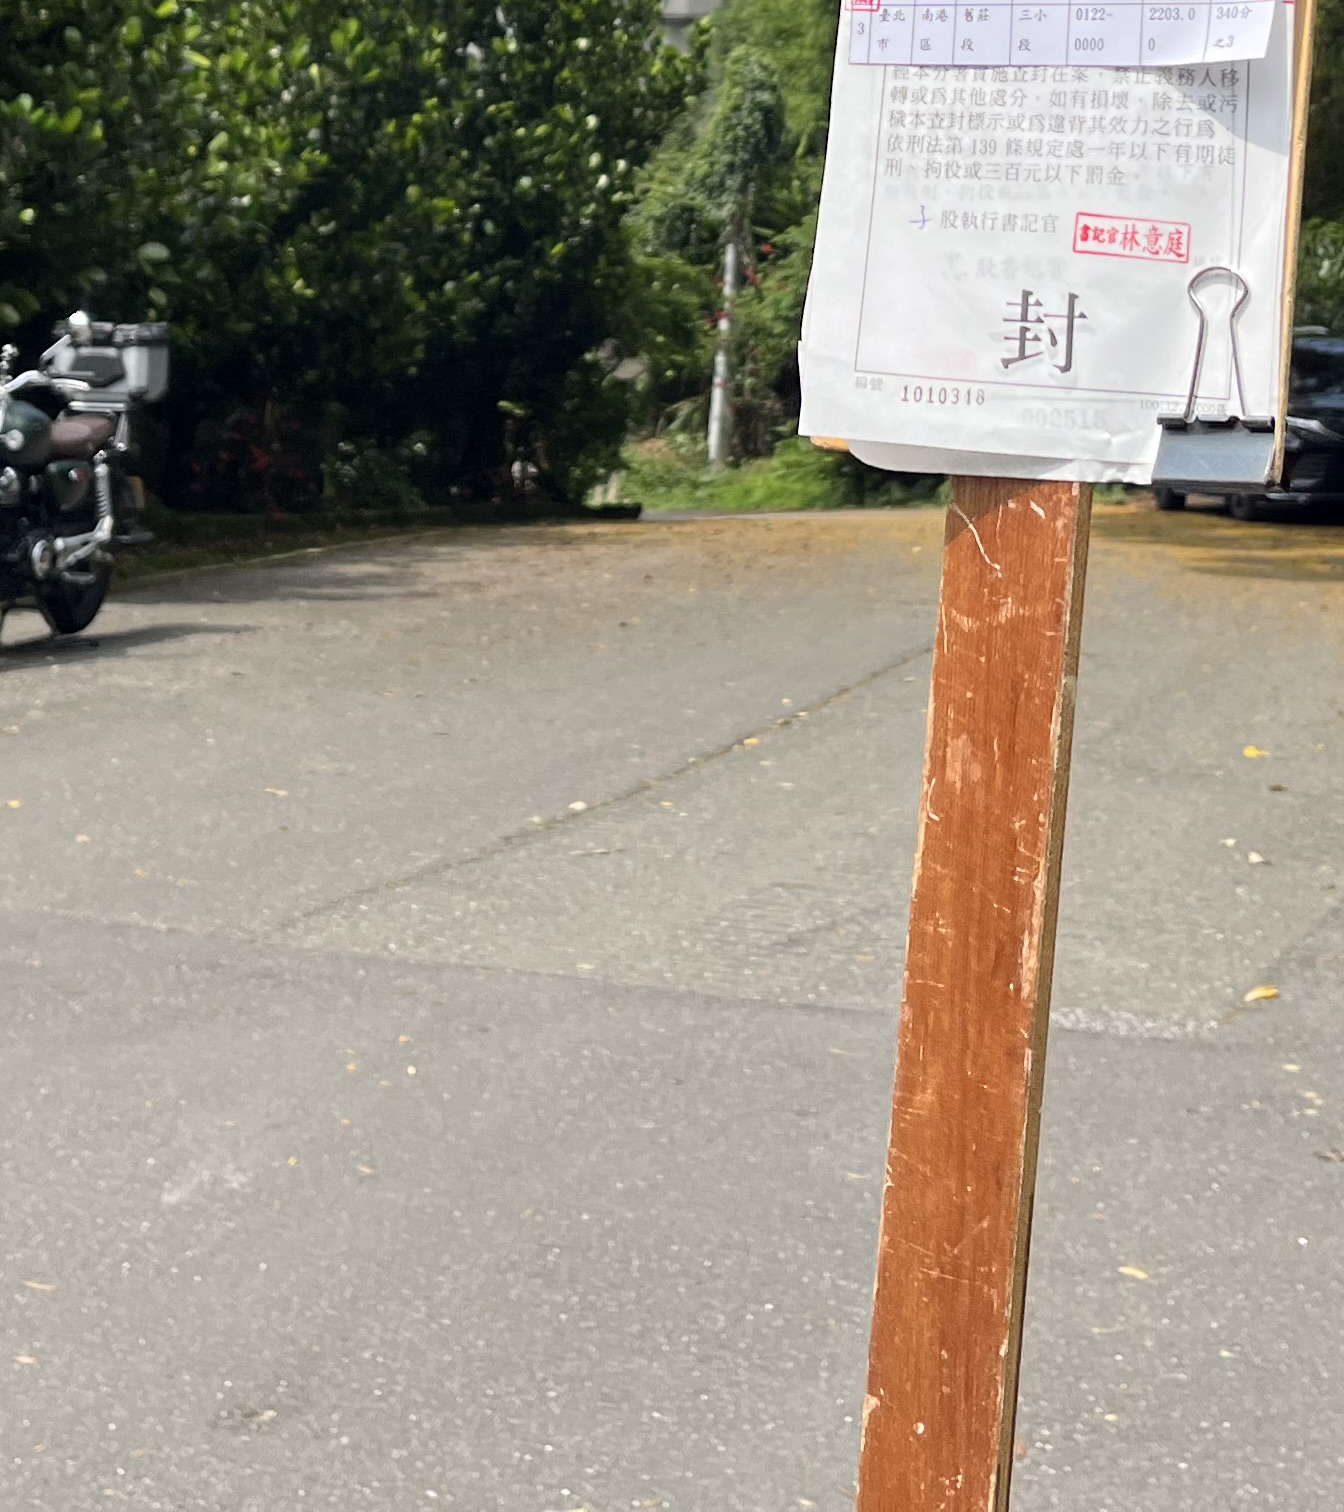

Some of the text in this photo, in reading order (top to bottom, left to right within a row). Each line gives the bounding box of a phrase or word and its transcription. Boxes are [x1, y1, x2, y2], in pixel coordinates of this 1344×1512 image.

[879, 8, 906, 22] 臺北
[921, 8, 949, 22] 南港
[1018, 8, 1047, 22] 三小
[1075, 7, 1113, 21] 0122-
[1215, 5, 1253, 20] 340分
[856, 22, 865, 35] 3
[877, 38, 890, 52] 市
[920, 38, 932, 51] 區
[960, 38, 975, 52] 段
[1017, 38, 1032, 52] 段
[1074, 37, 1105, 51] 0000
[1147, 37, 1156, 51] 0
[1212, 35, 1235, 48] 之3
[886, 135, 963, 155] 依刑法第
[971, 138, 998, 156] 139
[940, 209, 1059, 234] 股執行書記官
[1000, 288, 1089, 374] 封
[901, 384, 986, 406] 1010318
